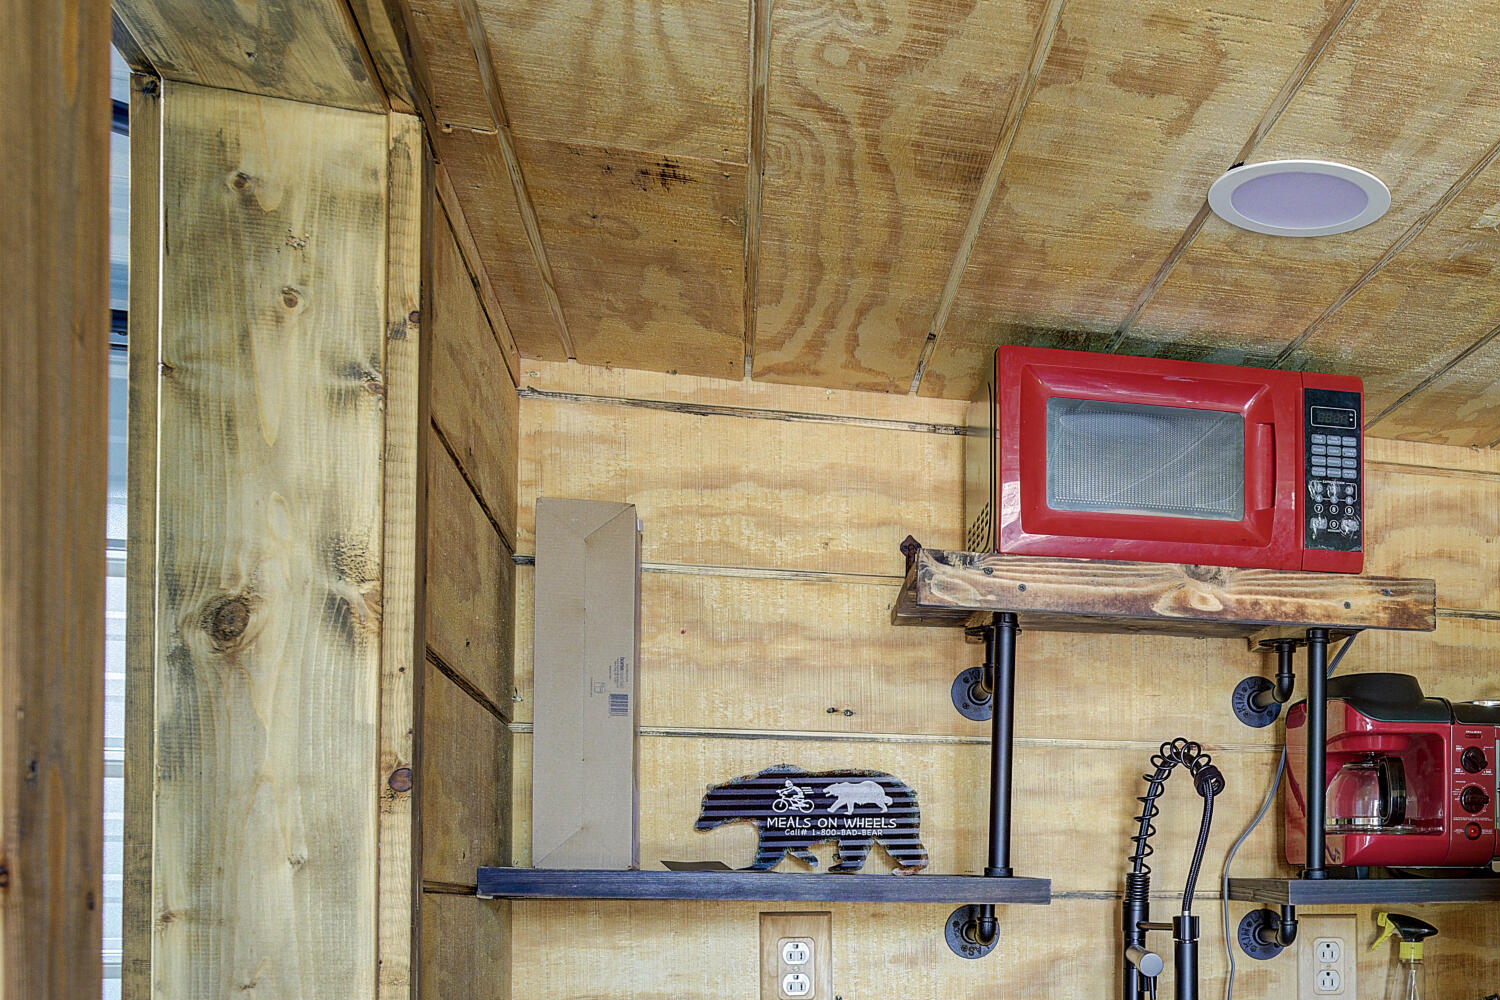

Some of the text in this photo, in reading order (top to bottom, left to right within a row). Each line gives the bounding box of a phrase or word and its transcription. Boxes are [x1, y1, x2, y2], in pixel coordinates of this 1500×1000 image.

[767, 816, 897, 828] MEALS ON WHEELS
